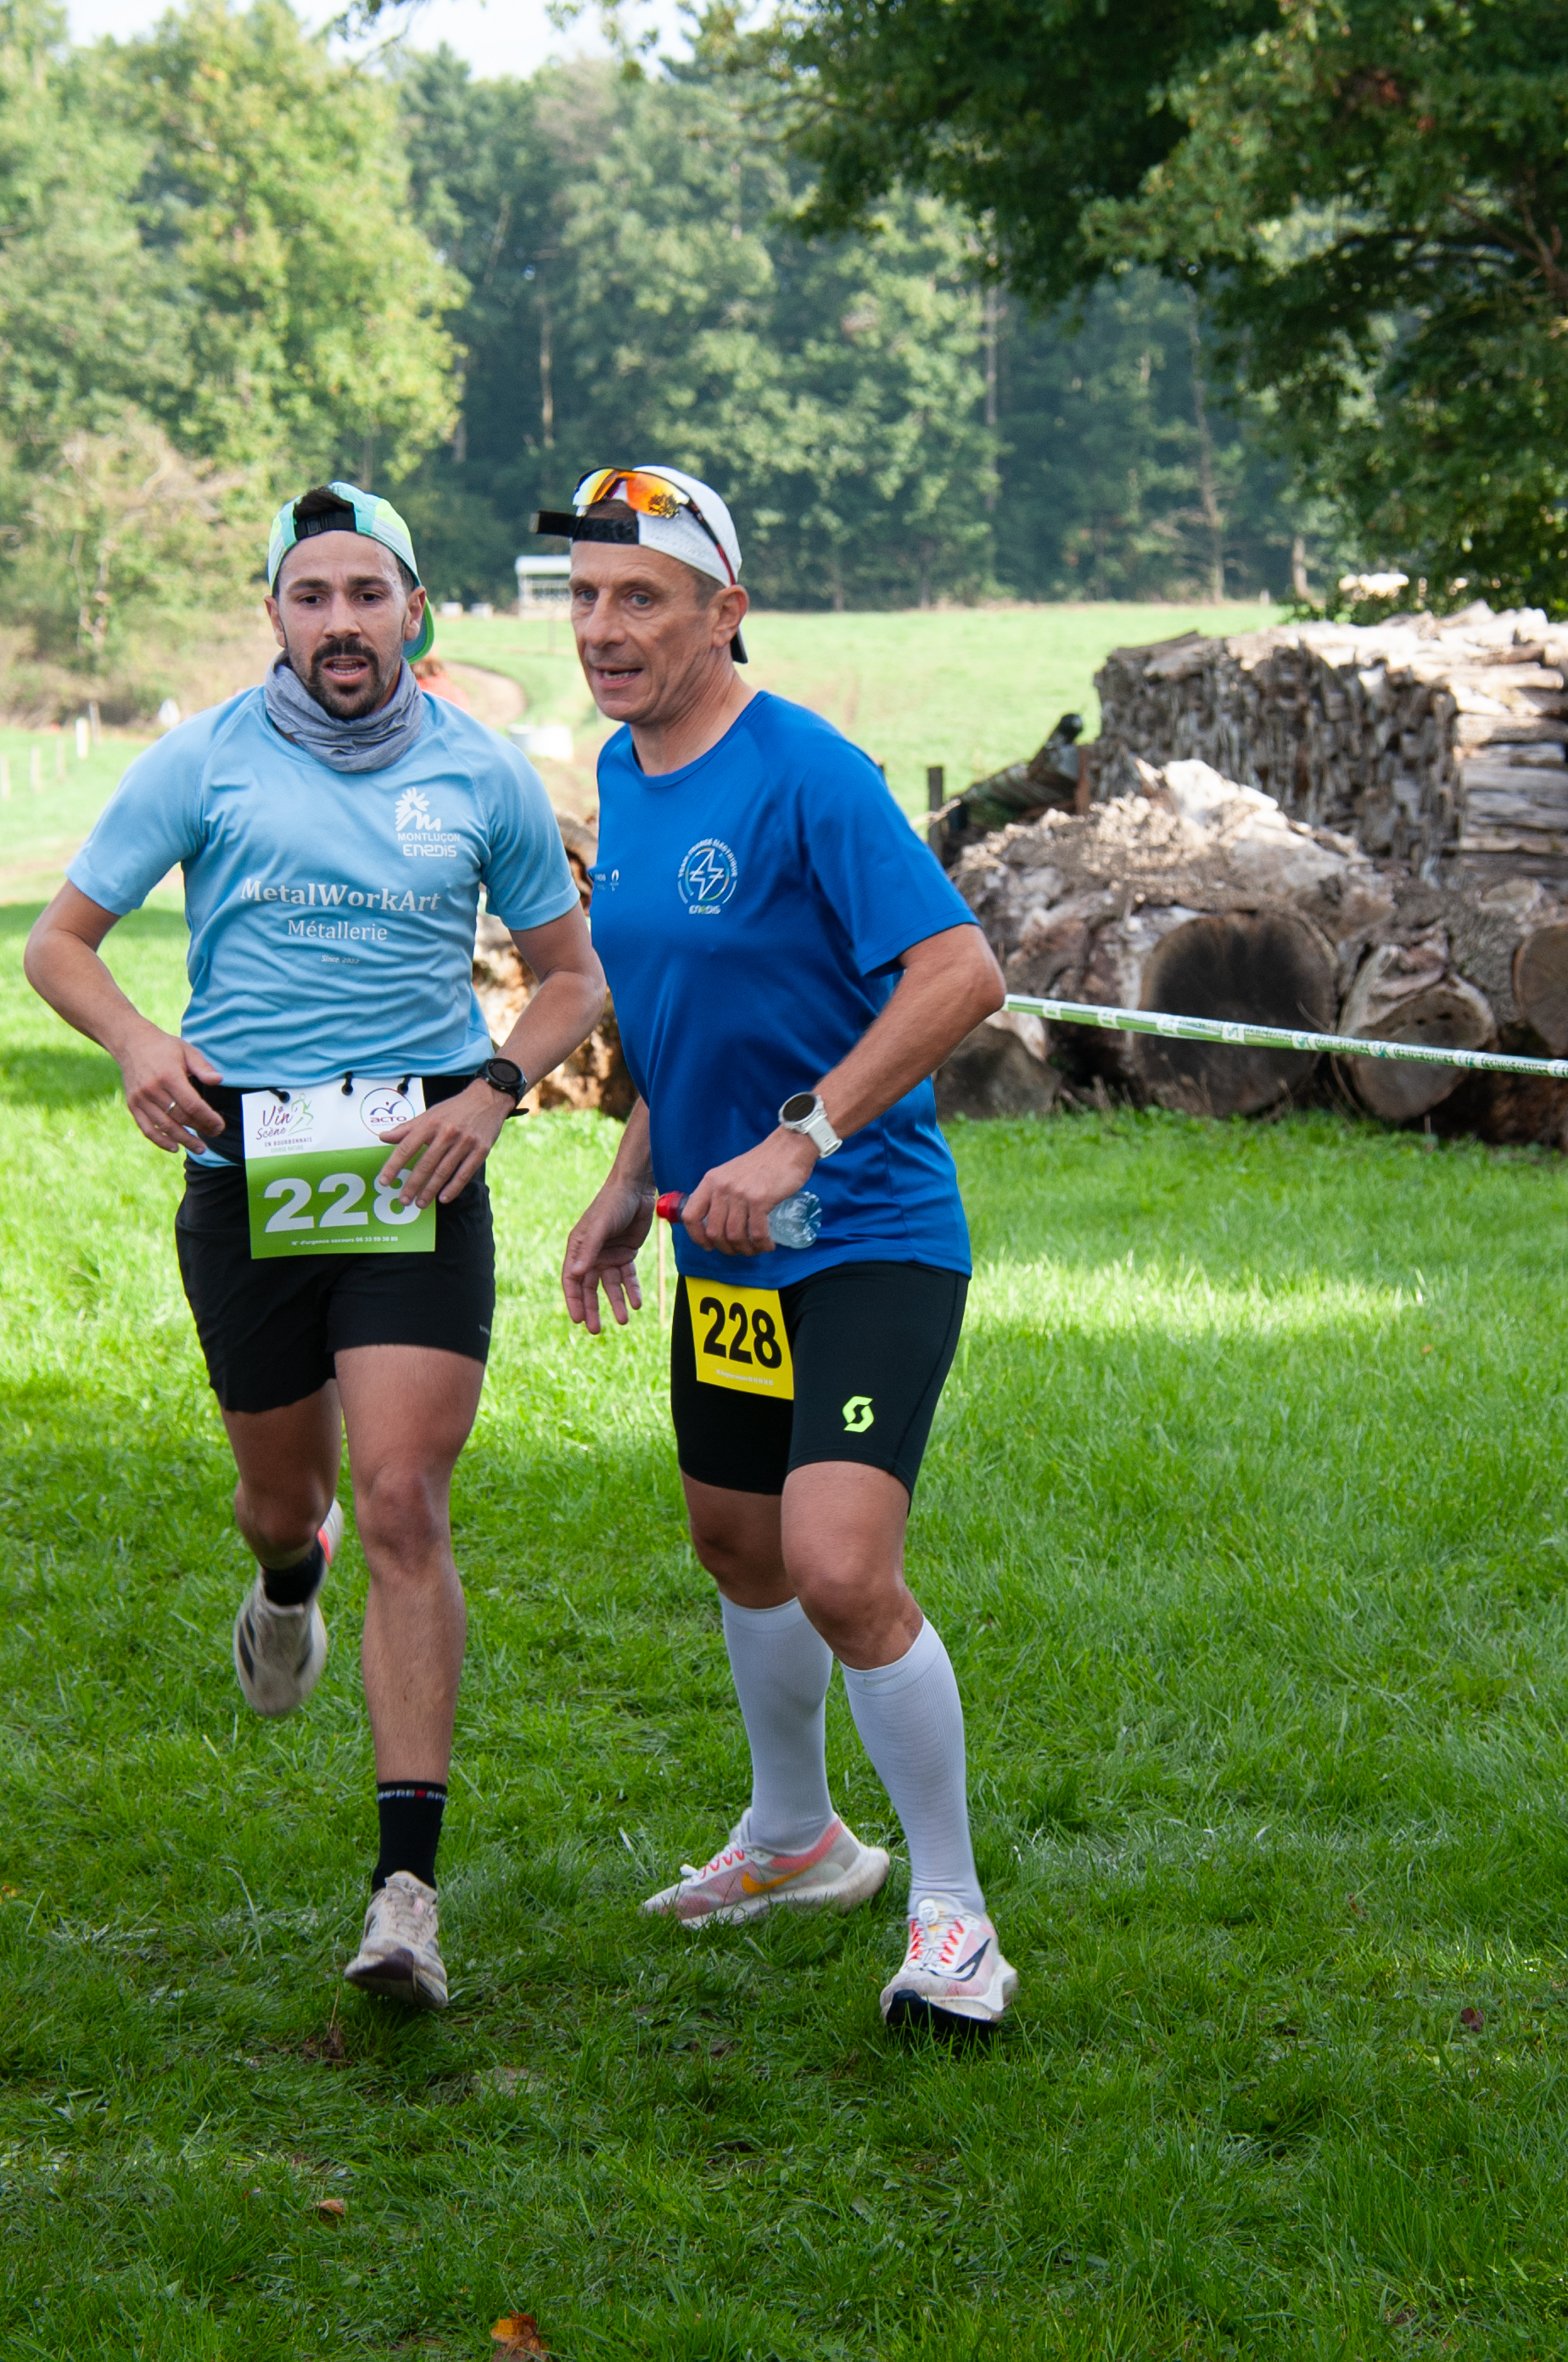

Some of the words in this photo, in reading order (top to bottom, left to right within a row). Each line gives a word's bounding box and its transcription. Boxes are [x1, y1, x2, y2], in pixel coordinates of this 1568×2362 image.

[397, 833, 460, 843] MONTLUÇON
[240, 878, 441, 912] MetalWorkArt
[287, 919, 388, 942] Métallerie
[264, 1168, 421, 1233] 228
[699, 1296, 783, 1369] 228
